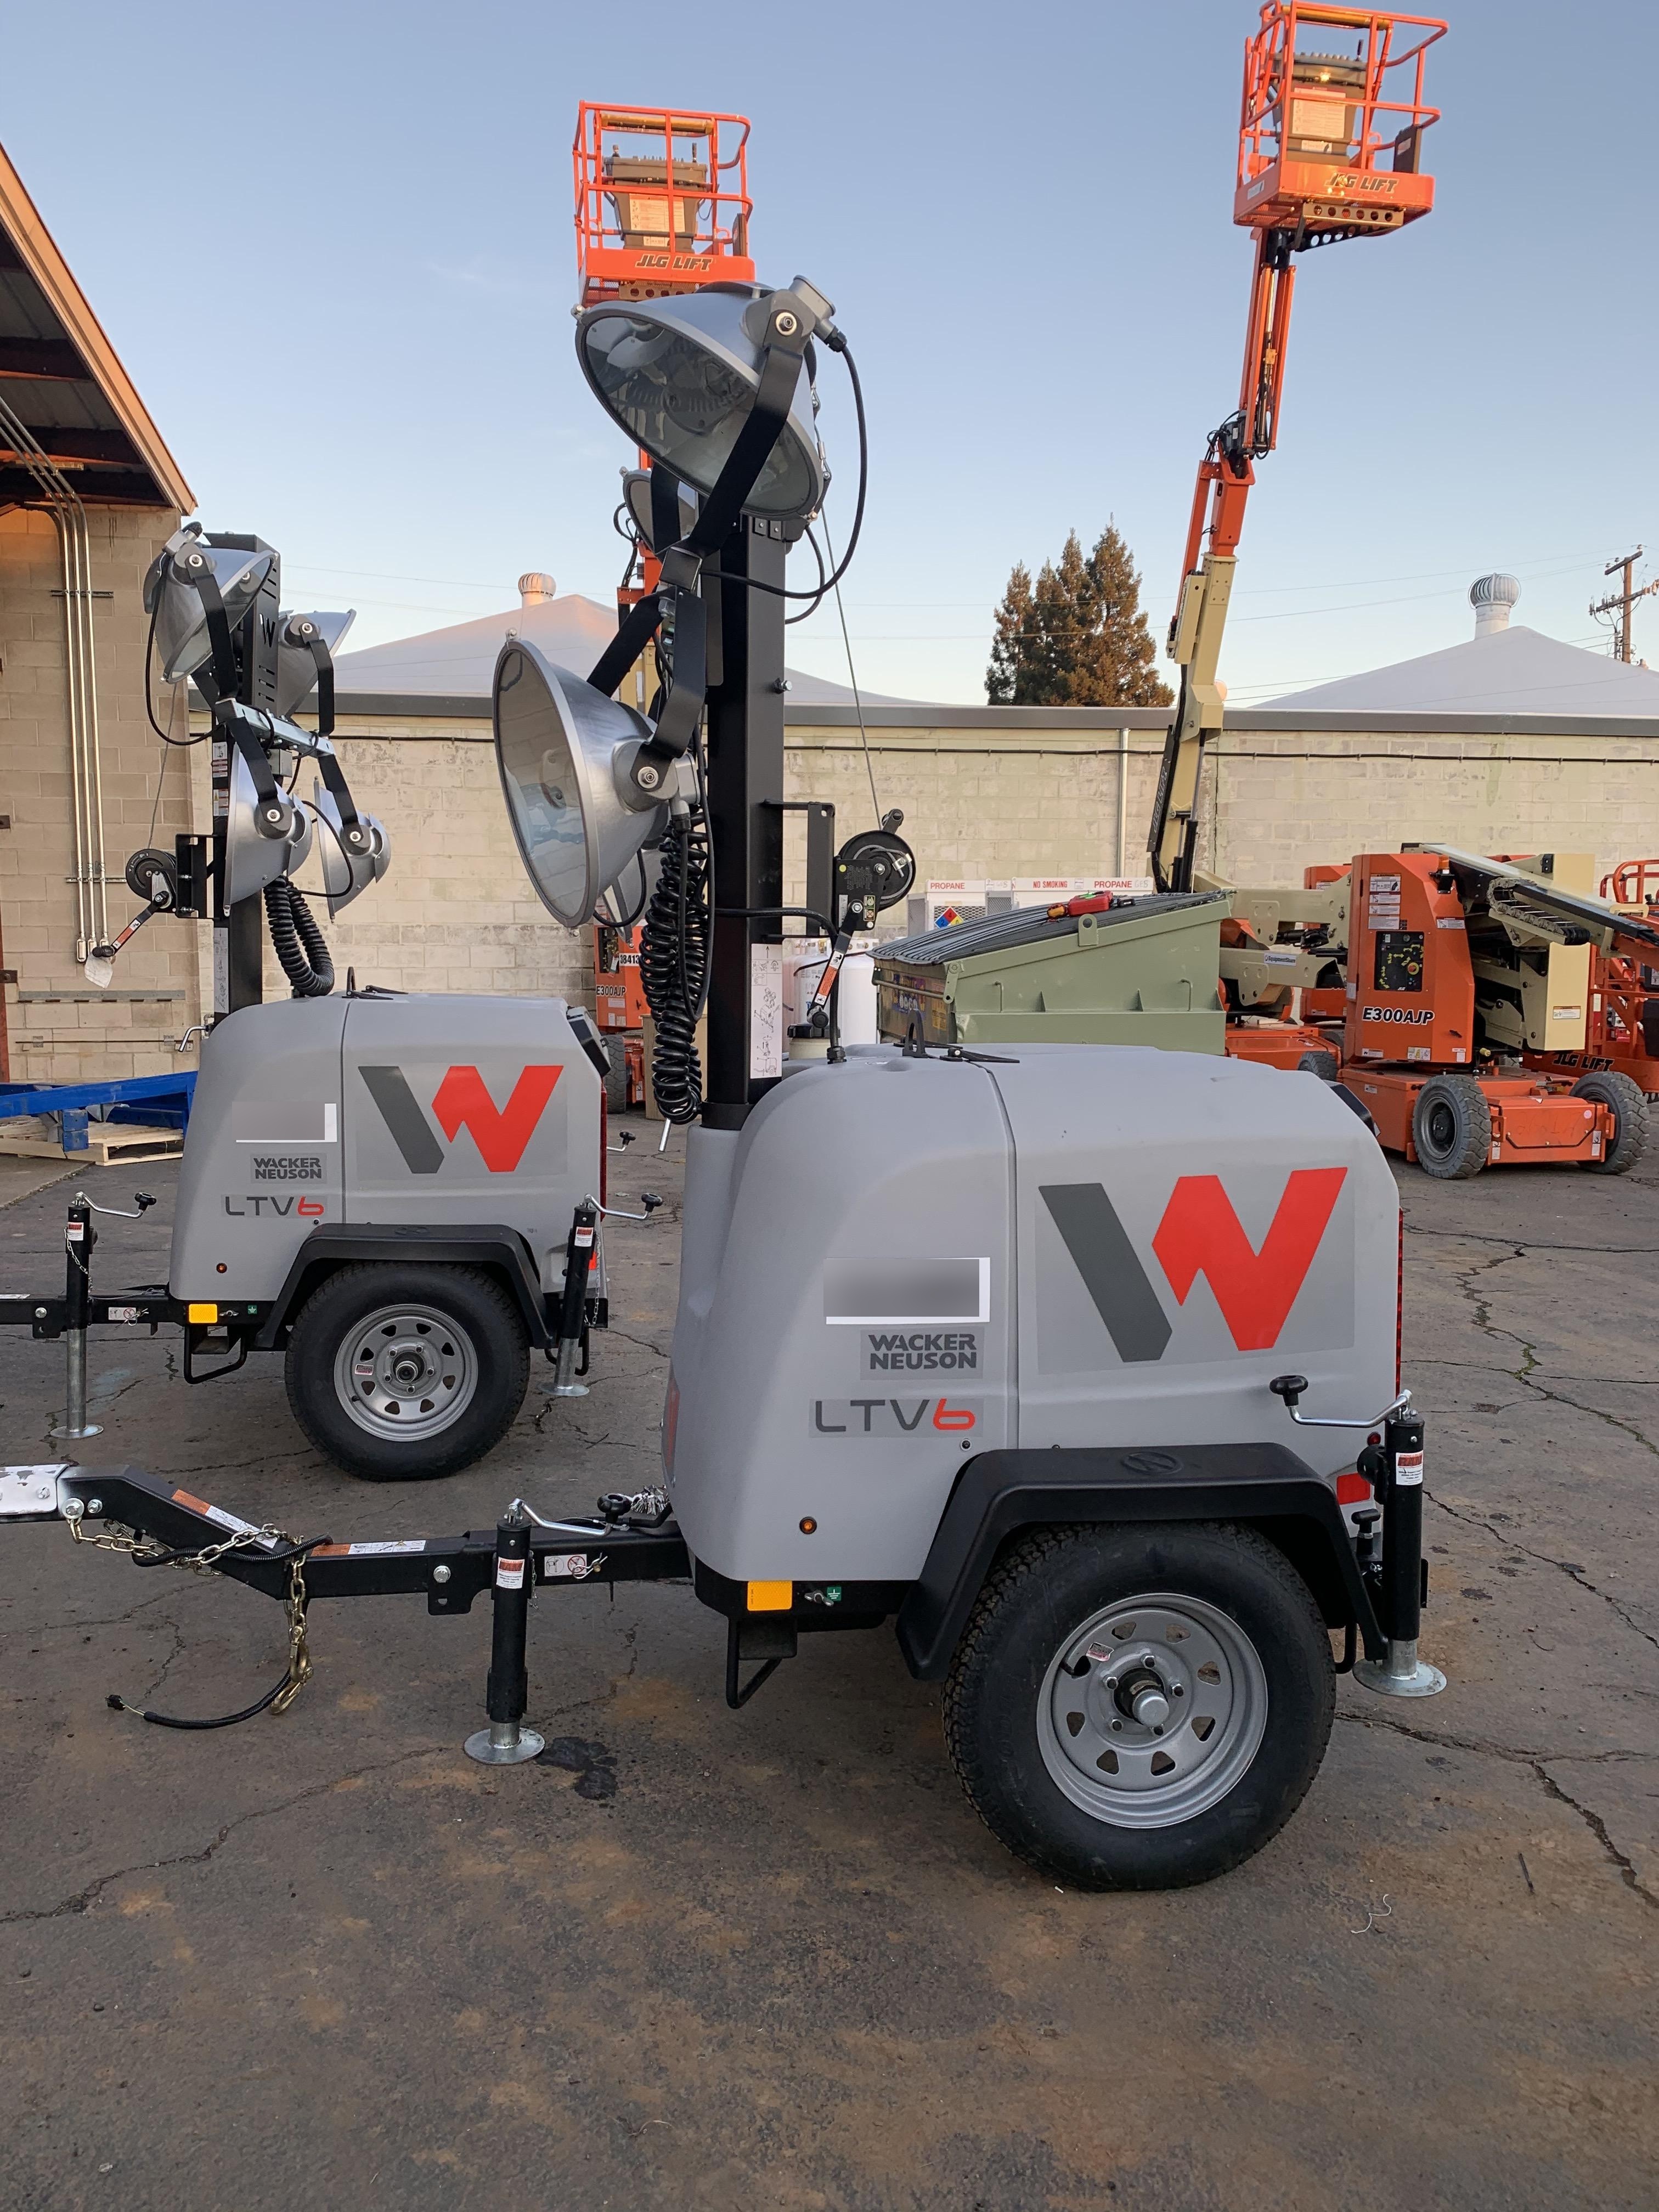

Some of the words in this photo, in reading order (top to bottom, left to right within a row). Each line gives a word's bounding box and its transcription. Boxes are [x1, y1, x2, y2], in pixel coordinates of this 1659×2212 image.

[1360, 176, 1400, 193] LIFT
[635, 254, 670, 268] JLG
[672, 256, 713, 271] LIFT
[596, 985, 627, 997] E300AJP
[1362, 1007, 1435, 1025] E300AJP
[1552, 1053, 1580, 1067] JLG
[1580, 1055, 1615, 1071] LIFT
[253, 1158, 321, 1168] WACKER
[255, 1169, 321, 1180] NEUSON
[225, 1196, 324, 1216] LTV6
[868, 1334, 977, 1351] WACKER
[870, 1352, 977, 1370] NEUSON
[815, 1398, 975, 1432] LTV6
